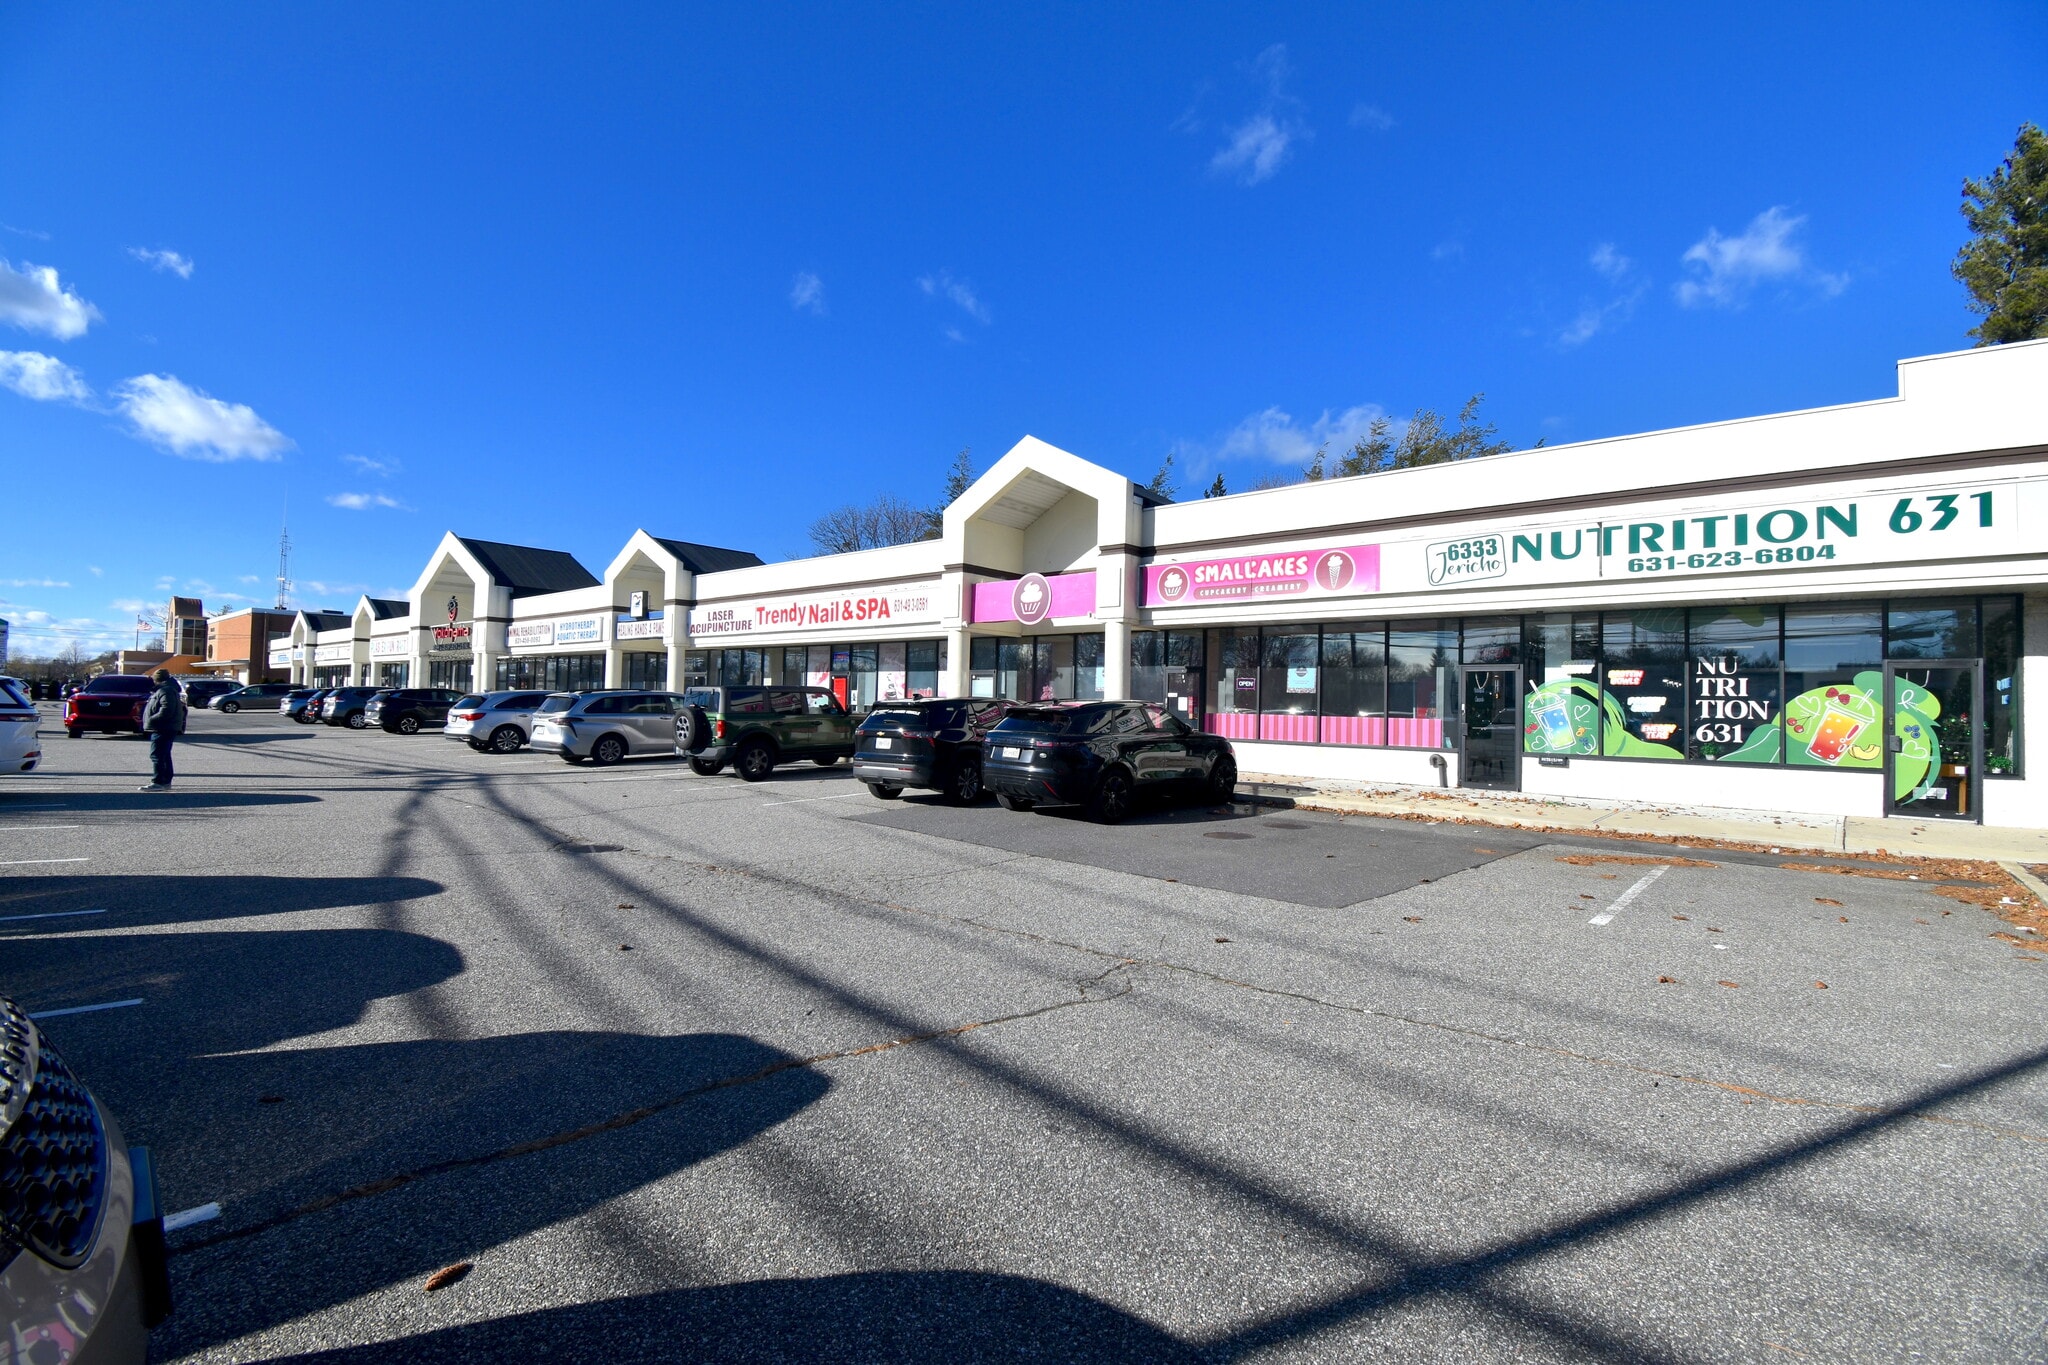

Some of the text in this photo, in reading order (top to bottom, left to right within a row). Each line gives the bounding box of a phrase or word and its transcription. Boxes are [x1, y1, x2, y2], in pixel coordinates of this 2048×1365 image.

[1512, 491, 1993, 563] NUTRITION 631
[1448, 538, 1497, 561] 6333
[1628, 544, 1836, 573] 631-623-6804
[1430, 551, 1503, 584] Jericho
[1200, 583, 1301, 596] CUPCAKERY CREAMERY
[708, 610, 733, 621] LASER
[756, 597, 890, 626] Trendy Nail & SPA
[560, 620, 596, 631] HYDROTHERAPY
[690, 620, 752, 634] ACUPUNCTURE
[557, 630, 598, 641] AQUATIC THERAPY
[1696, 656, 1738, 675] NU
[1696, 678, 1748, 696] TRI
[1696, 700, 1769, 720] TION
[1696, 723, 1743, 743] 631
